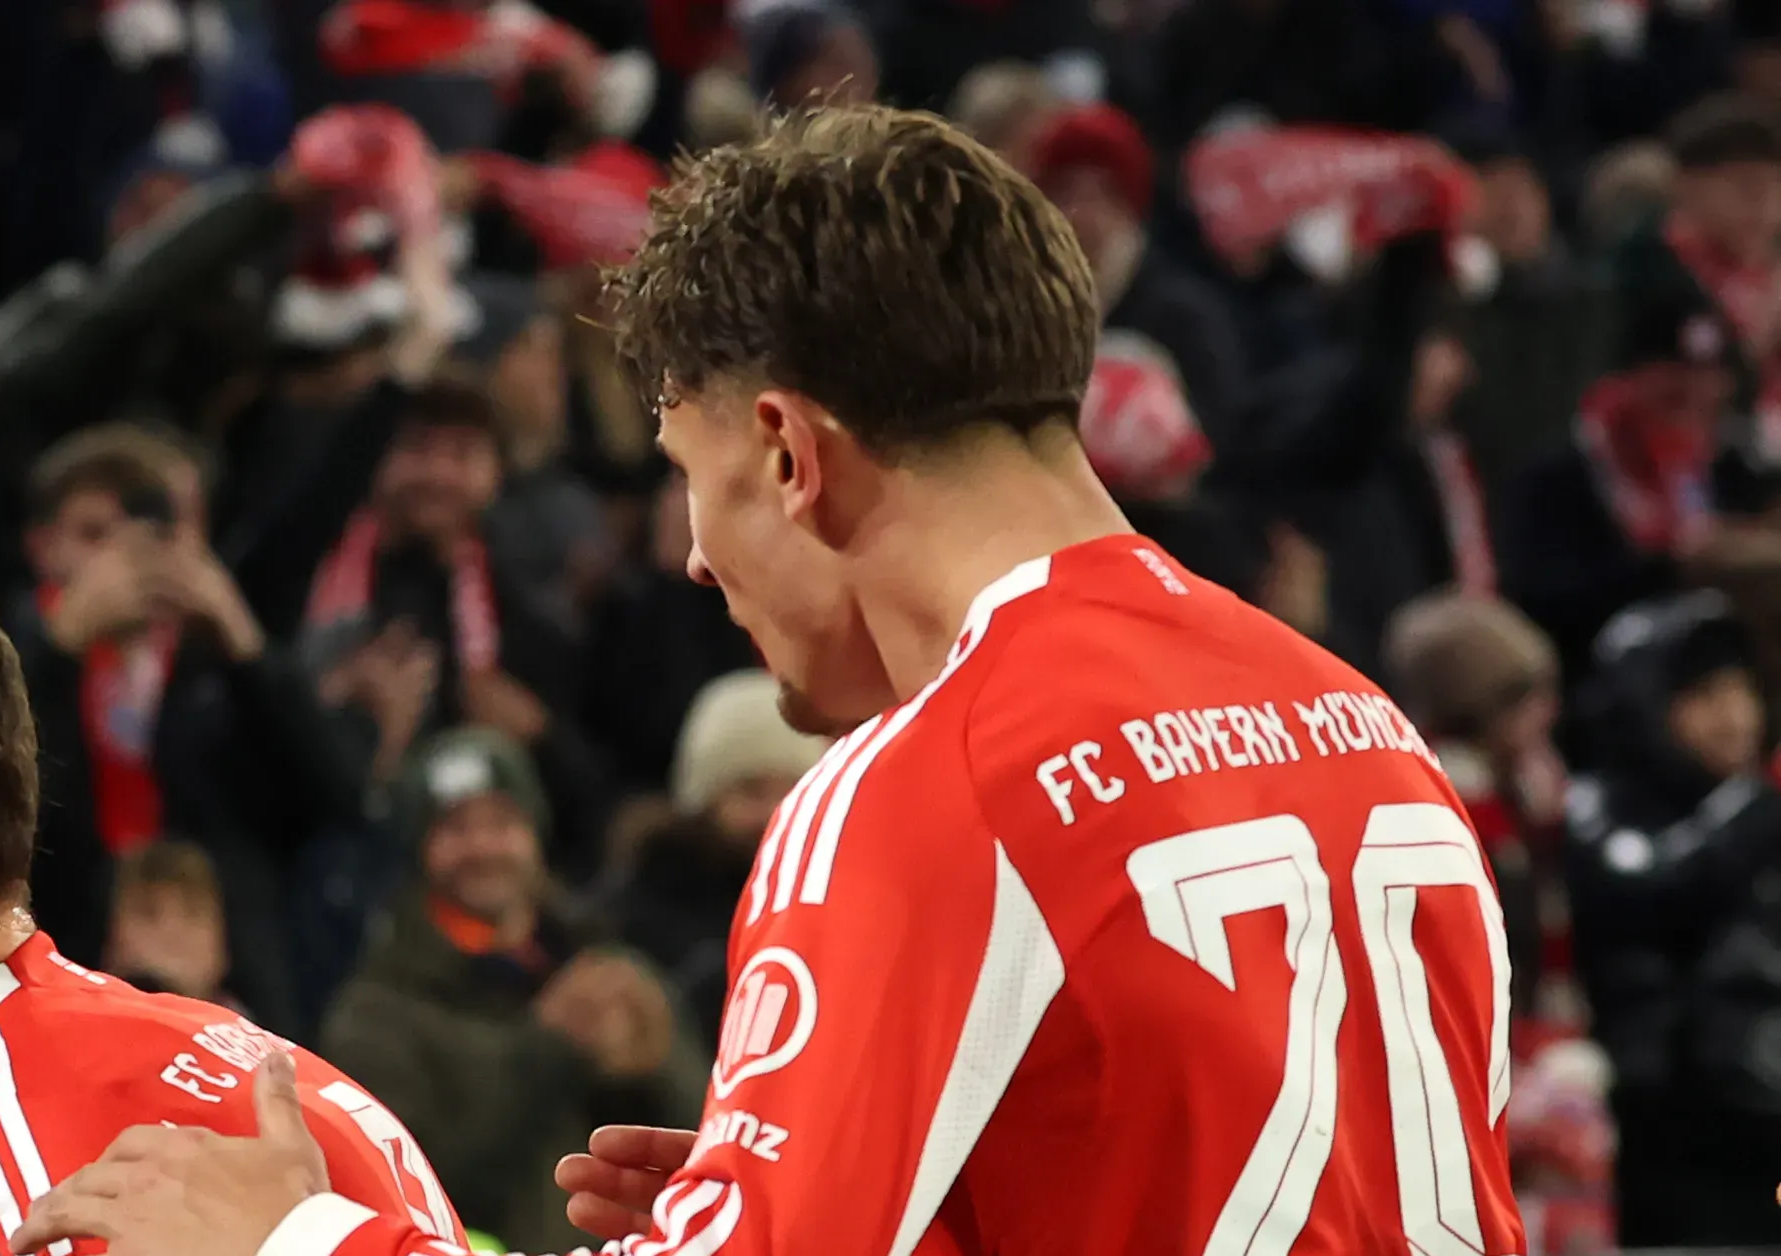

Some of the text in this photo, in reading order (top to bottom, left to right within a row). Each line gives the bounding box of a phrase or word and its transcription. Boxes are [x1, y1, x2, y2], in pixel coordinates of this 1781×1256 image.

[1035, 735, 1126, 826] FC
[1119, 700, 1301, 784] BAYERN
[160, 1052, 239, 1104] FC
